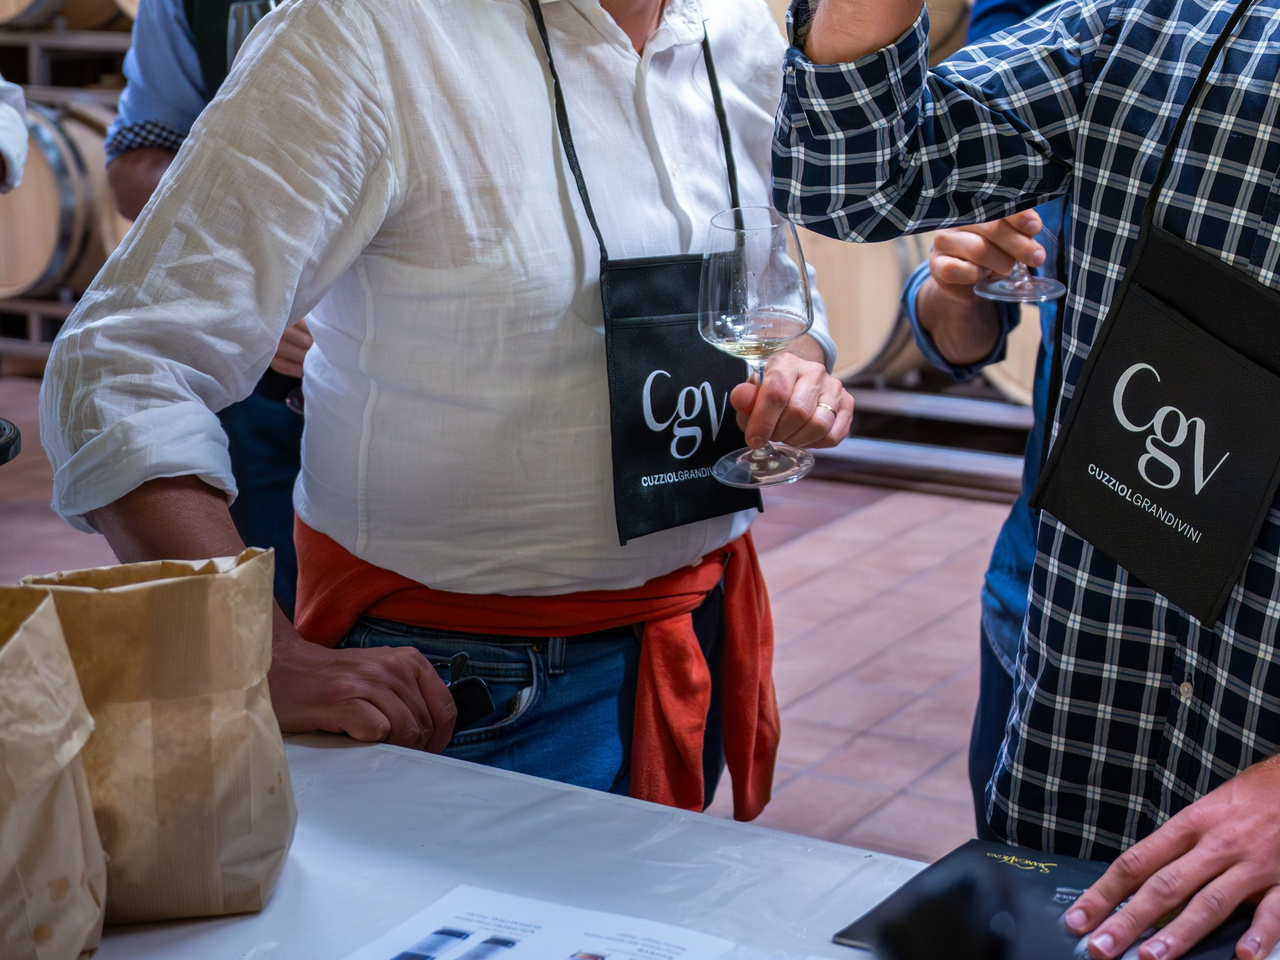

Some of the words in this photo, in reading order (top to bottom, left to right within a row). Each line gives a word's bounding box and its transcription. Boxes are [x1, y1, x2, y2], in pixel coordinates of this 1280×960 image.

[1112, 362, 1230, 496] Cgv
[641, 466, 713, 487] CUZZIOLGRANDI
[1087, 463, 1203, 544] CUZZIOLGRANDIVINI
